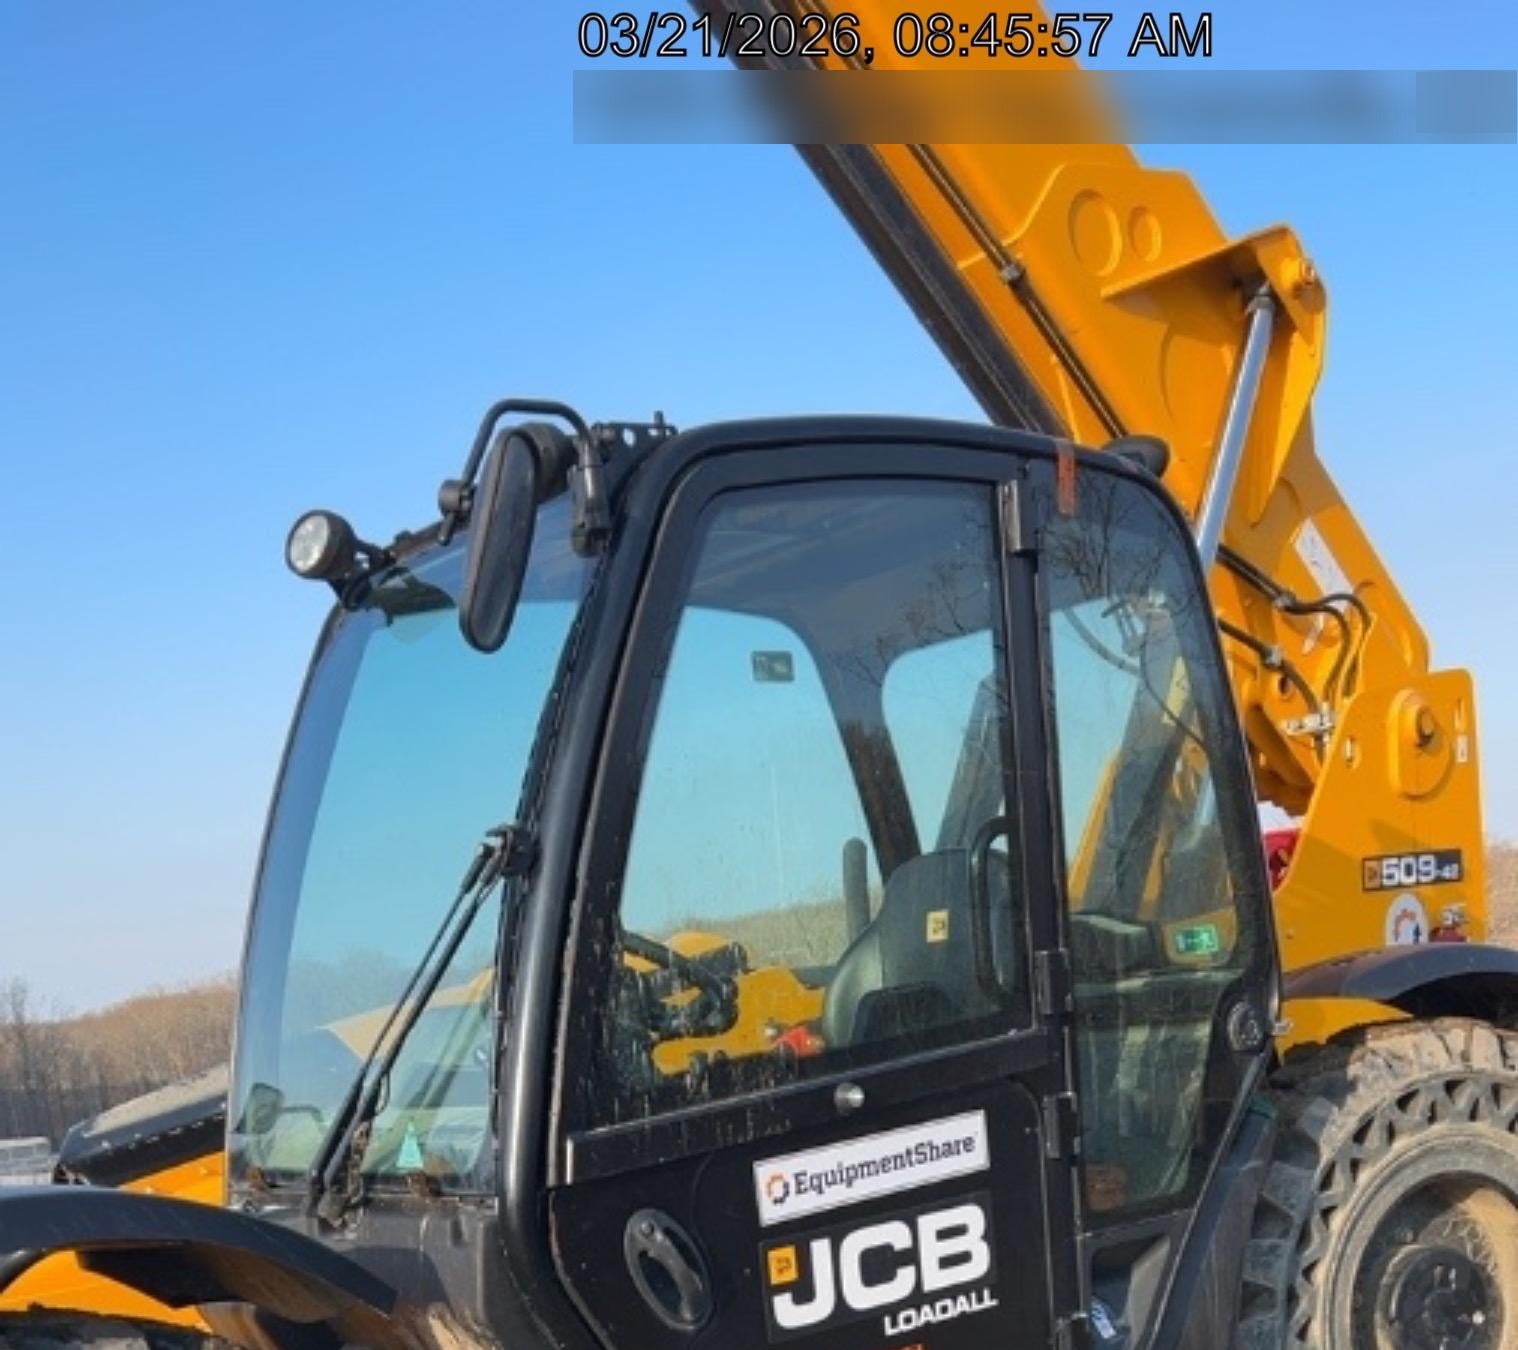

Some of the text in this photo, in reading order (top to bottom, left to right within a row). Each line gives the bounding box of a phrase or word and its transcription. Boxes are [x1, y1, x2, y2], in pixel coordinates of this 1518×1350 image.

[793, 1135, 976, 1195] EquipmentShare
[772, 1202, 991, 1331] JCB
[883, 1287, 1000, 1337] LOADALL
